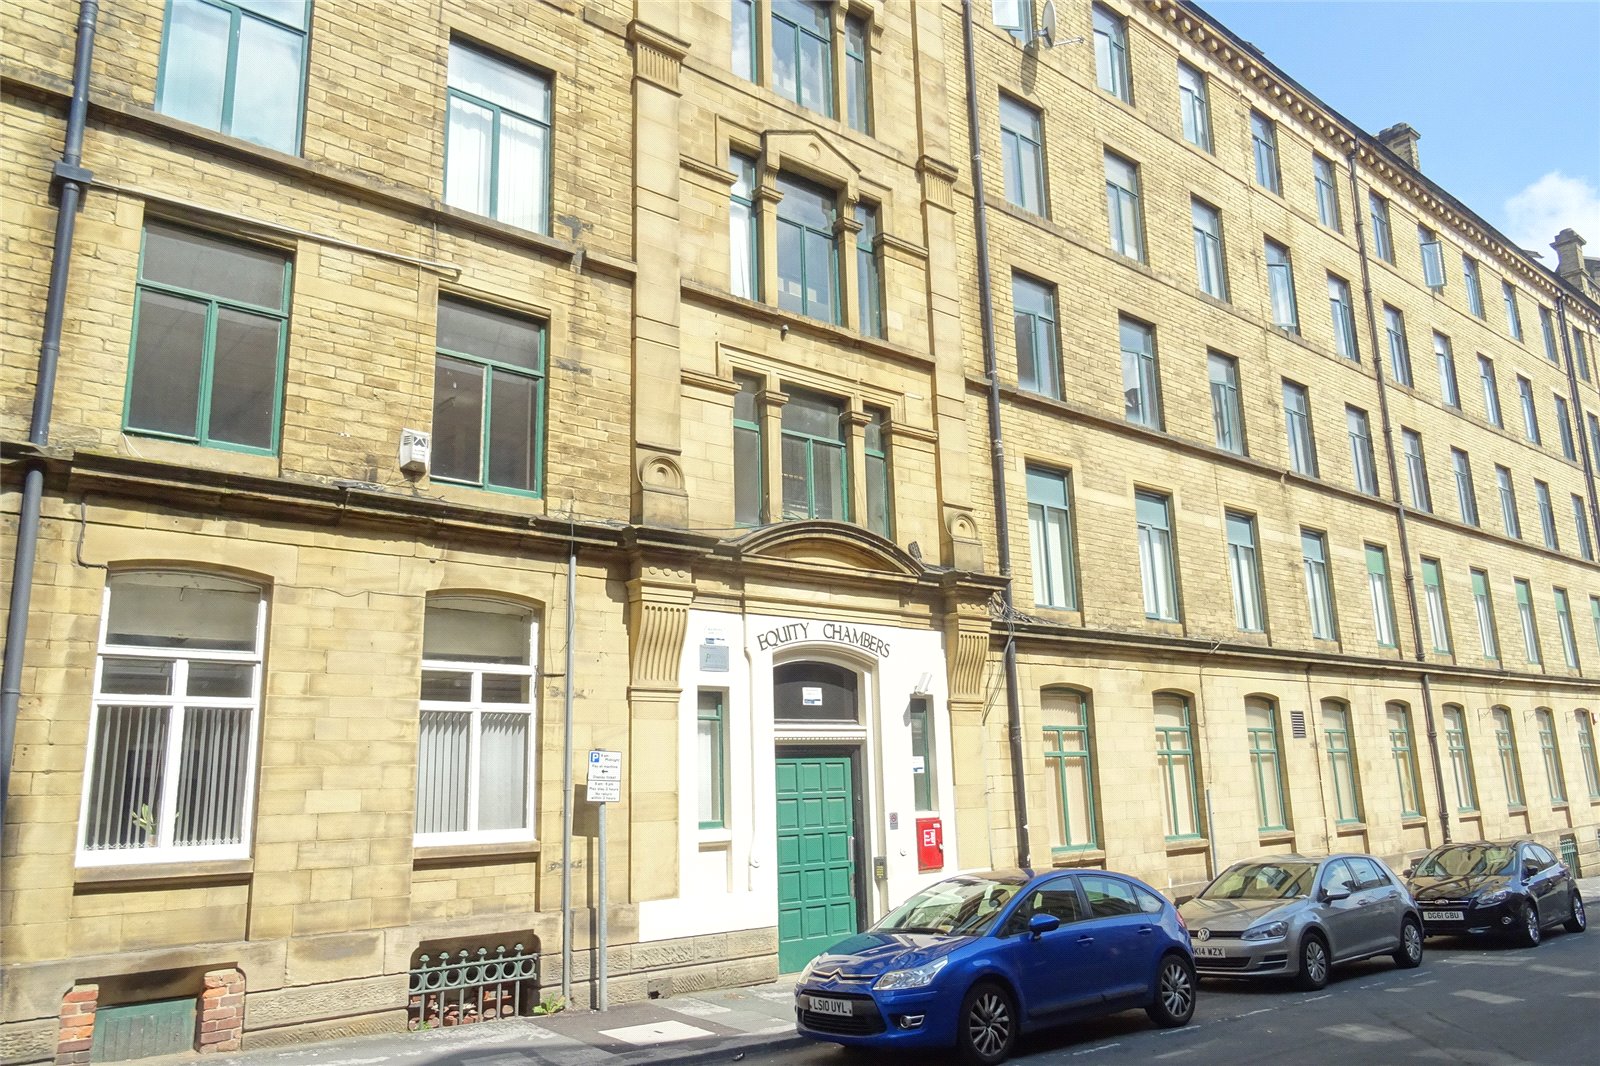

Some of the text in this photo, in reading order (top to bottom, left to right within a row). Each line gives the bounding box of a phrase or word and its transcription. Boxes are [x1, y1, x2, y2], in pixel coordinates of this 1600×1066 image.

[757, 622, 891, 658] EQUITY CHAMBERS
[592, 753, 599, 762] P
[1193, 947, 1223, 956] K14 WZX
[831, 1000, 847, 1014] UYL
